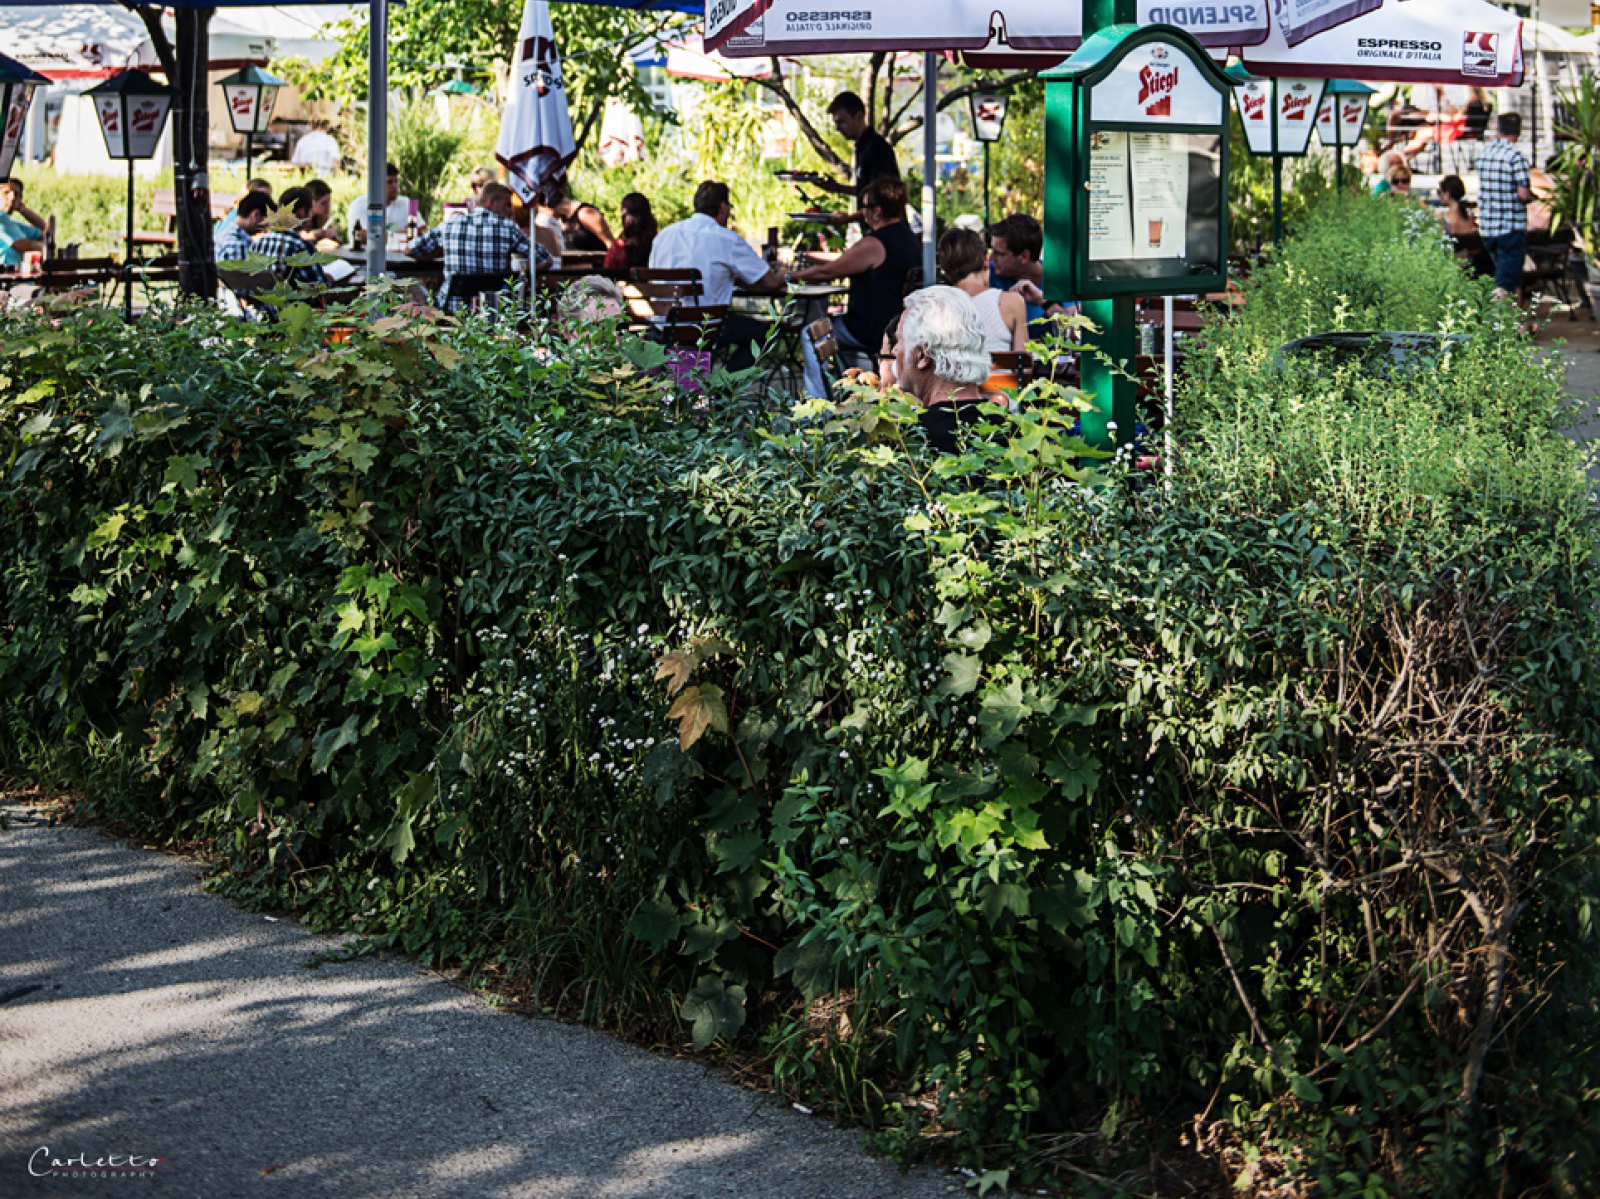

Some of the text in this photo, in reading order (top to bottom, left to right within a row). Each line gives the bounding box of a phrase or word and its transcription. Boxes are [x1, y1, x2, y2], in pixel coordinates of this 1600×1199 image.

[1357, 38, 1442, 51] ESPRESSO
[1357, 49, 1402, 59] ORIGINALE
[1138, 65, 1178, 105] Stiegl
